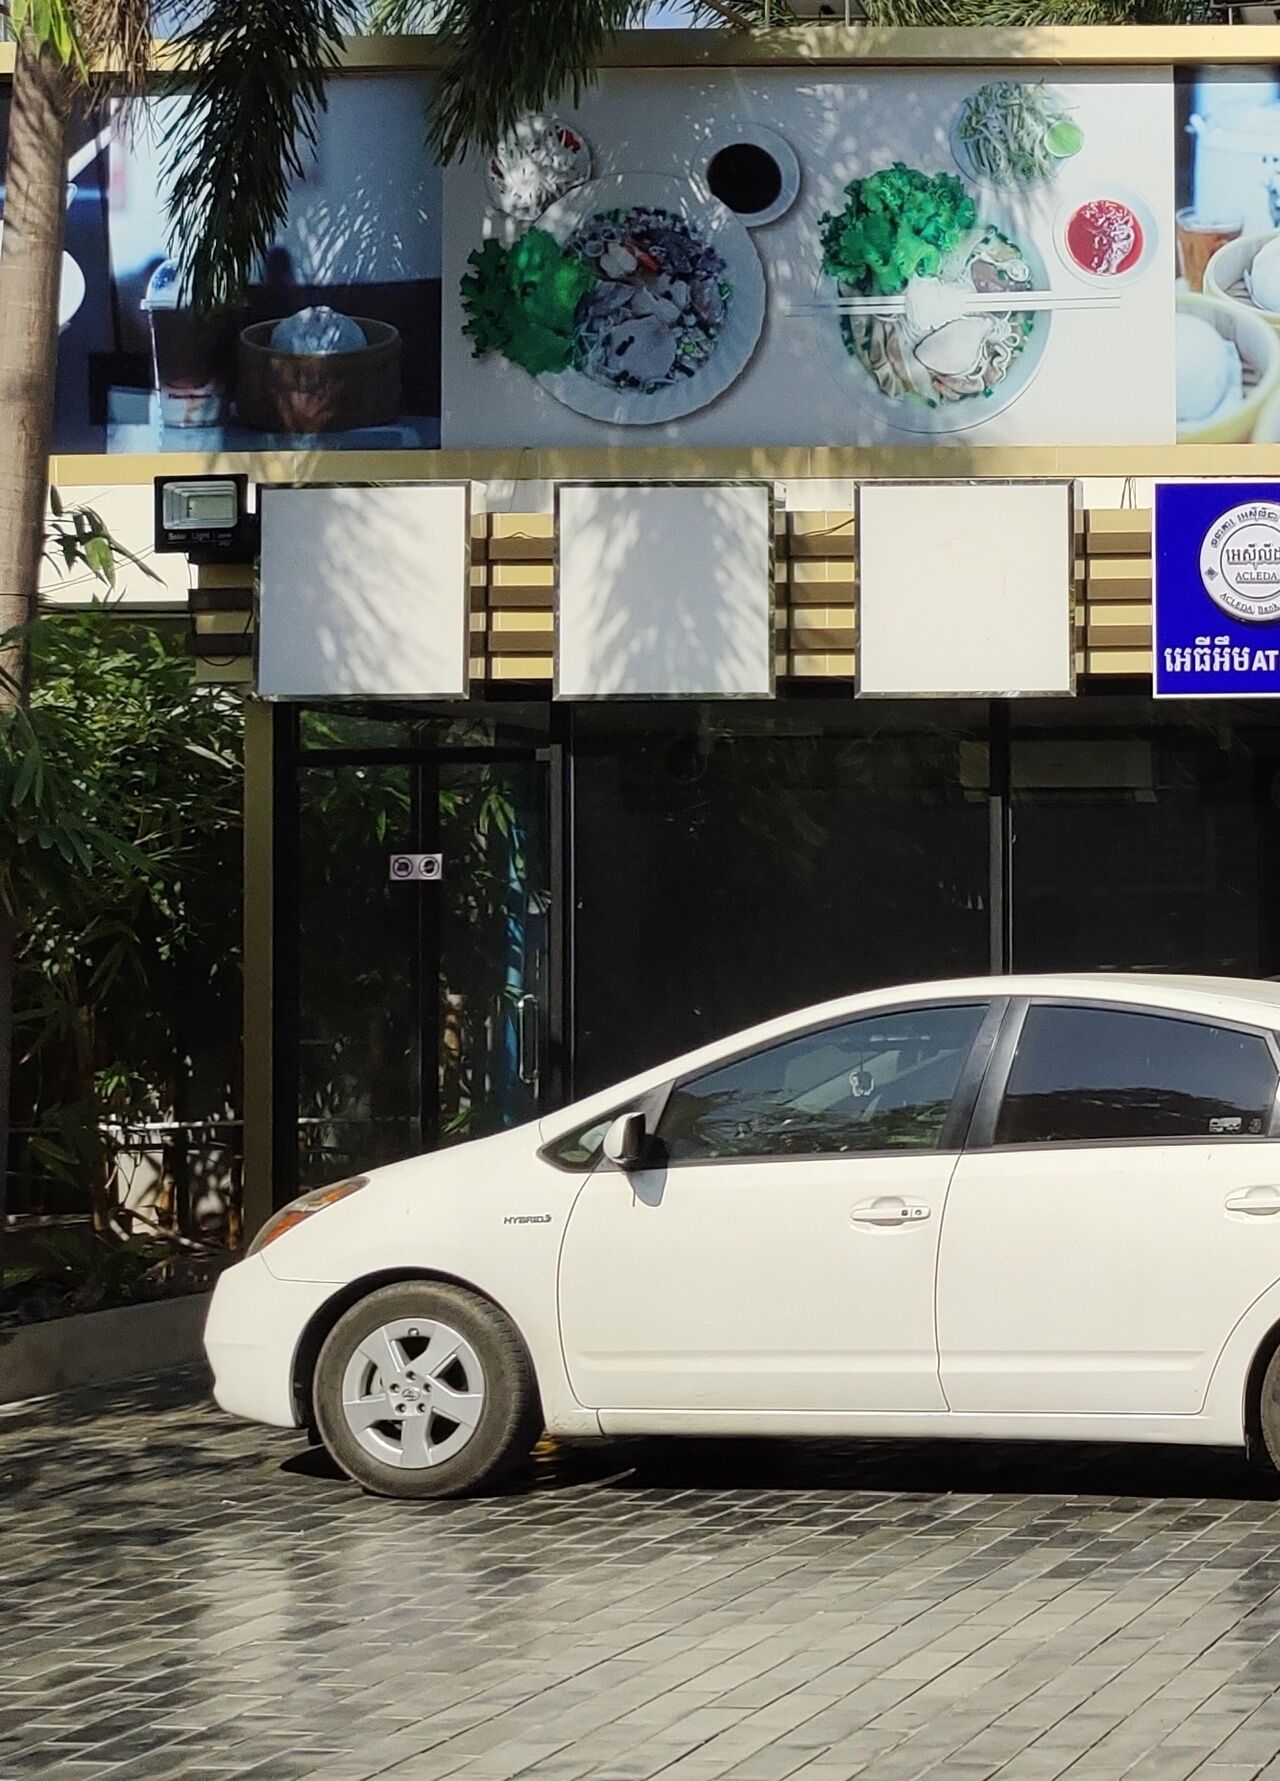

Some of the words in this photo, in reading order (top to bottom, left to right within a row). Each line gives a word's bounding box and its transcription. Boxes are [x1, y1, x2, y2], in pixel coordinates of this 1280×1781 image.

[1235, 571, 1278, 582] ACLEDA
[1220, 592, 1252, 613] ACLEDA
[1258, 603, 1280, 614] Bank
[504, 1216, 544, 1224] HYBRID
